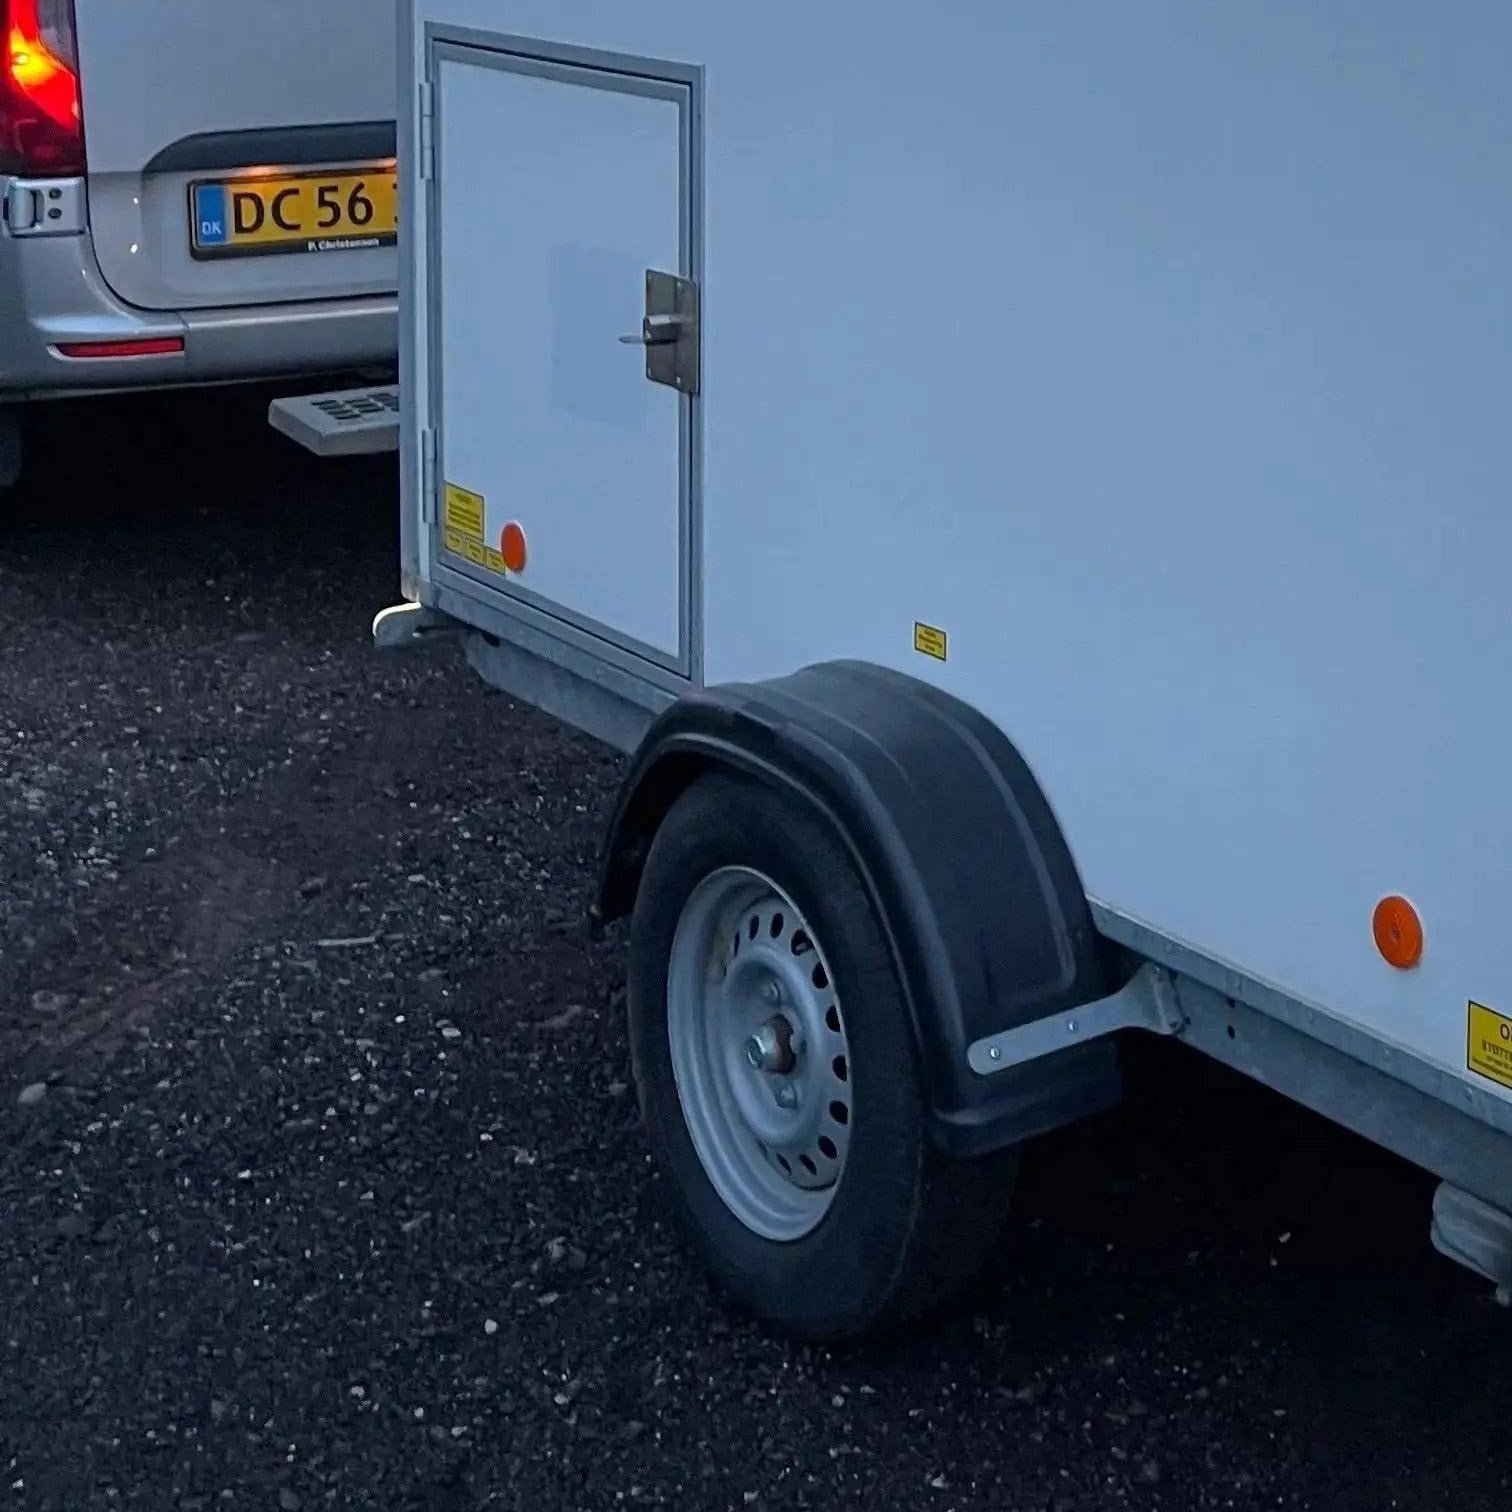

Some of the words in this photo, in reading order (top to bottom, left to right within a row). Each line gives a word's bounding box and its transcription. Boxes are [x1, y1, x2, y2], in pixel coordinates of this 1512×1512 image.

[233, 188, 301, 234] DC
[318, 182, 374, 228] 56
[202, 221, 222, 236] DK
